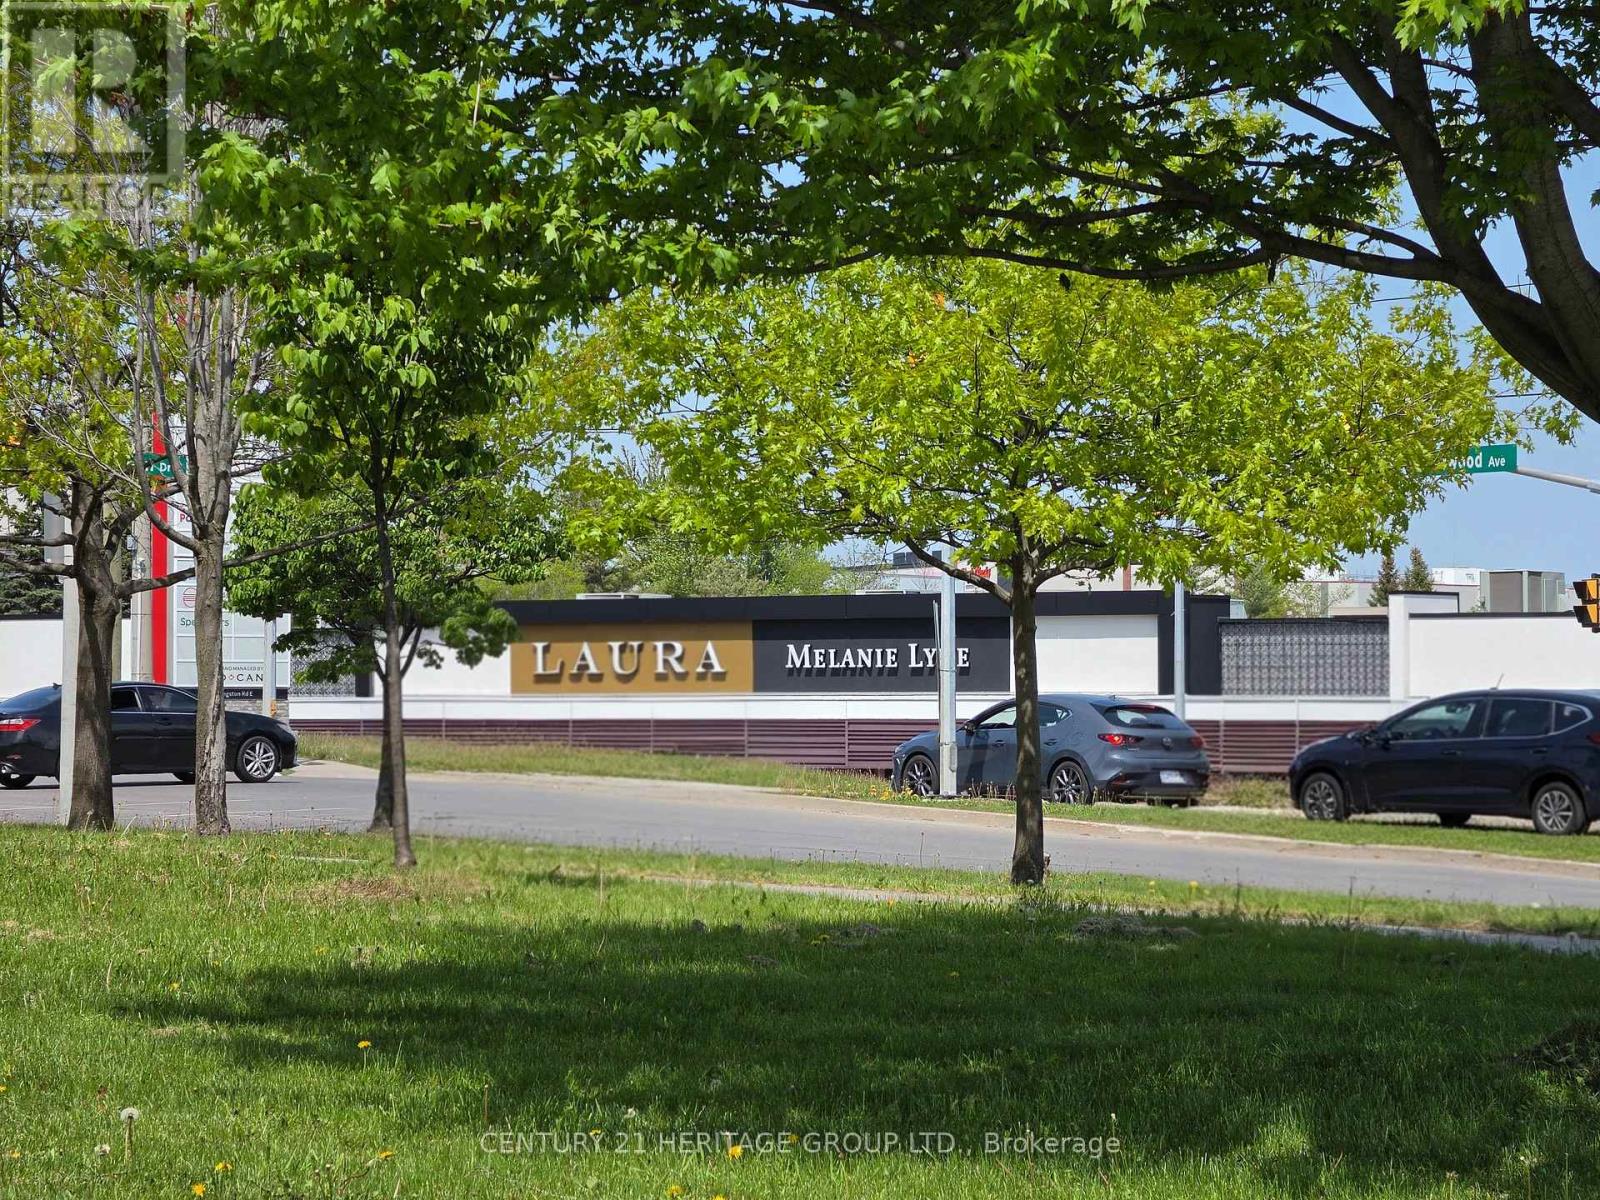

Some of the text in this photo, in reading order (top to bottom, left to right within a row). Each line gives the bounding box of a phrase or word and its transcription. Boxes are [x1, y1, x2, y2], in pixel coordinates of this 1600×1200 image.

[1444, 451, 1506, 469] wood Ave
[533, 641, 726, 676] LAURA
[785, 643, 970, 669] MELANIE LYE
